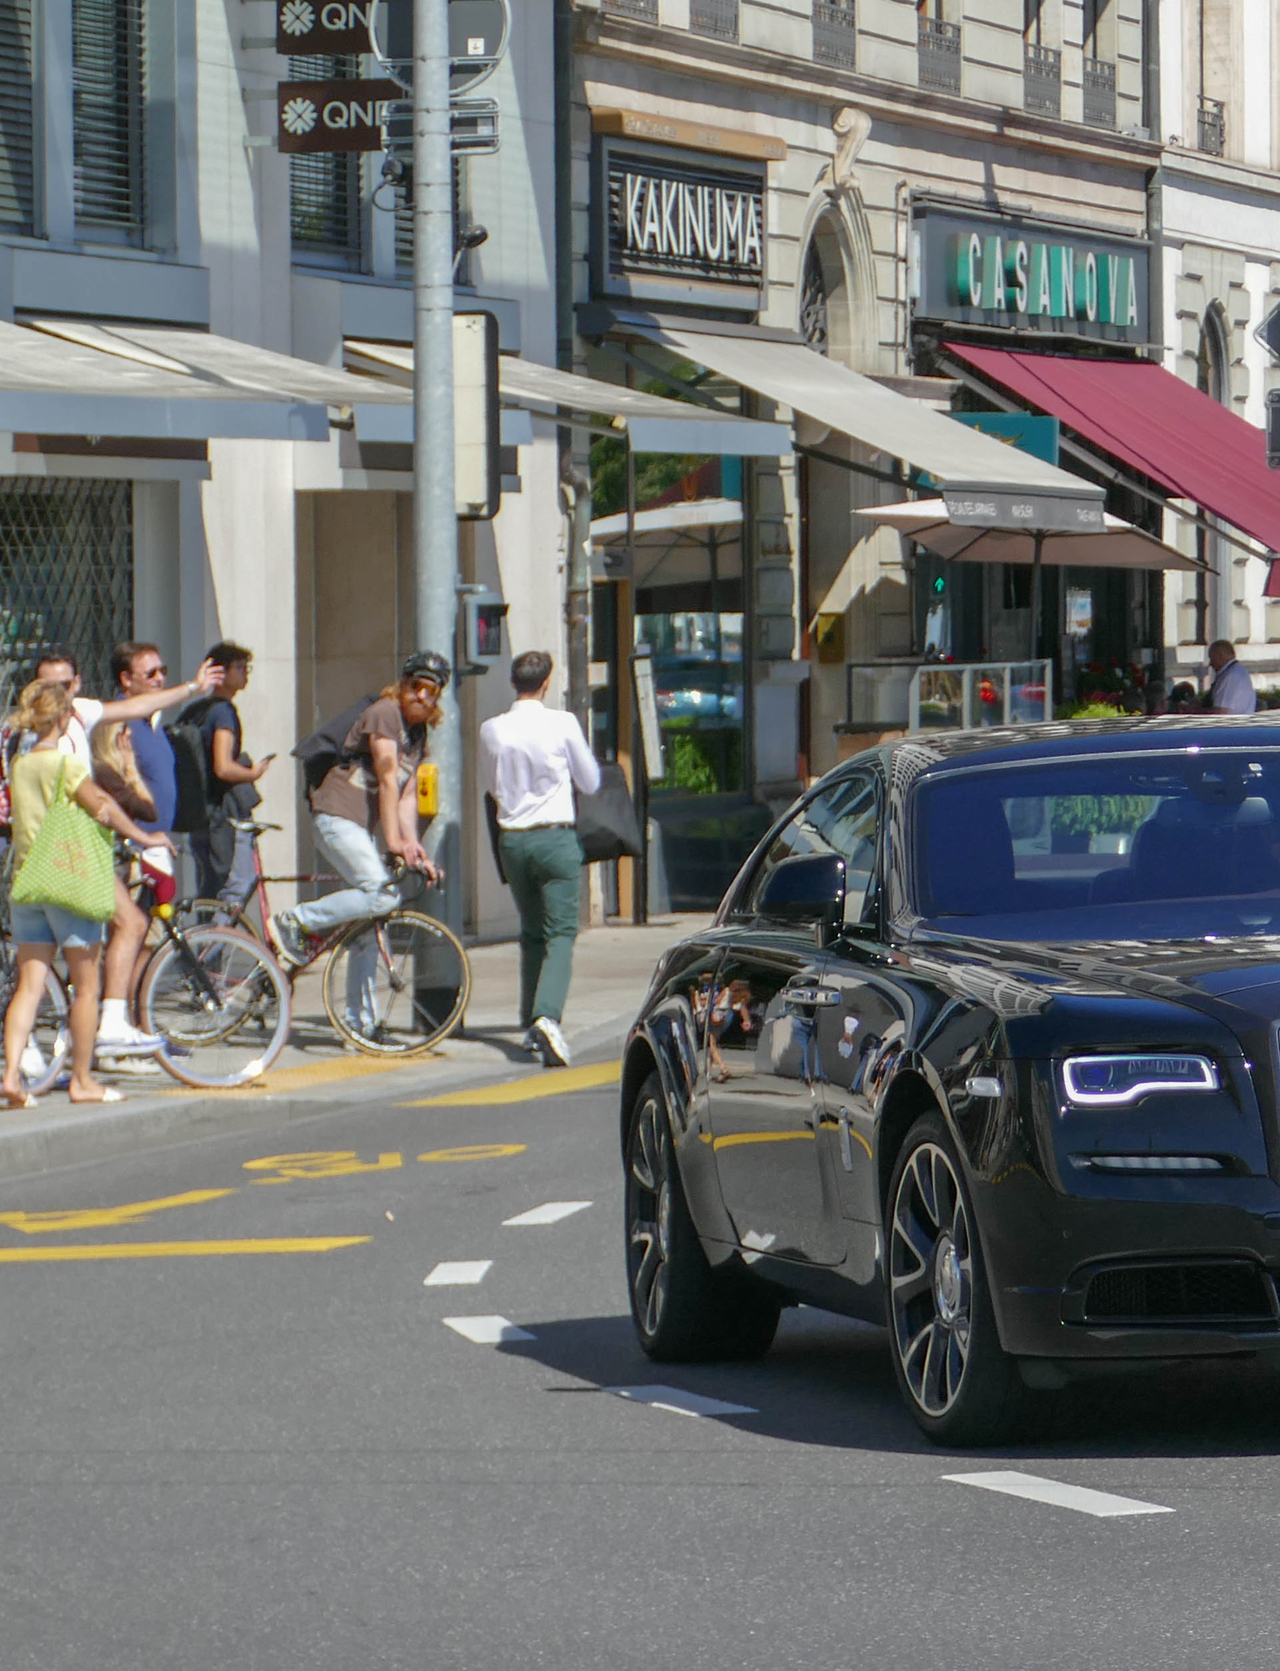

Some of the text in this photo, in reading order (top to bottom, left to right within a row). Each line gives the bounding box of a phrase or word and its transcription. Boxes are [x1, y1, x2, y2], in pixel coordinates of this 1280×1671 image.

[320, 2, 371, 30] QN
[626, 173, 761, 265] KAKINUMA
[959, 233, 1138, 327] CASANOVA
